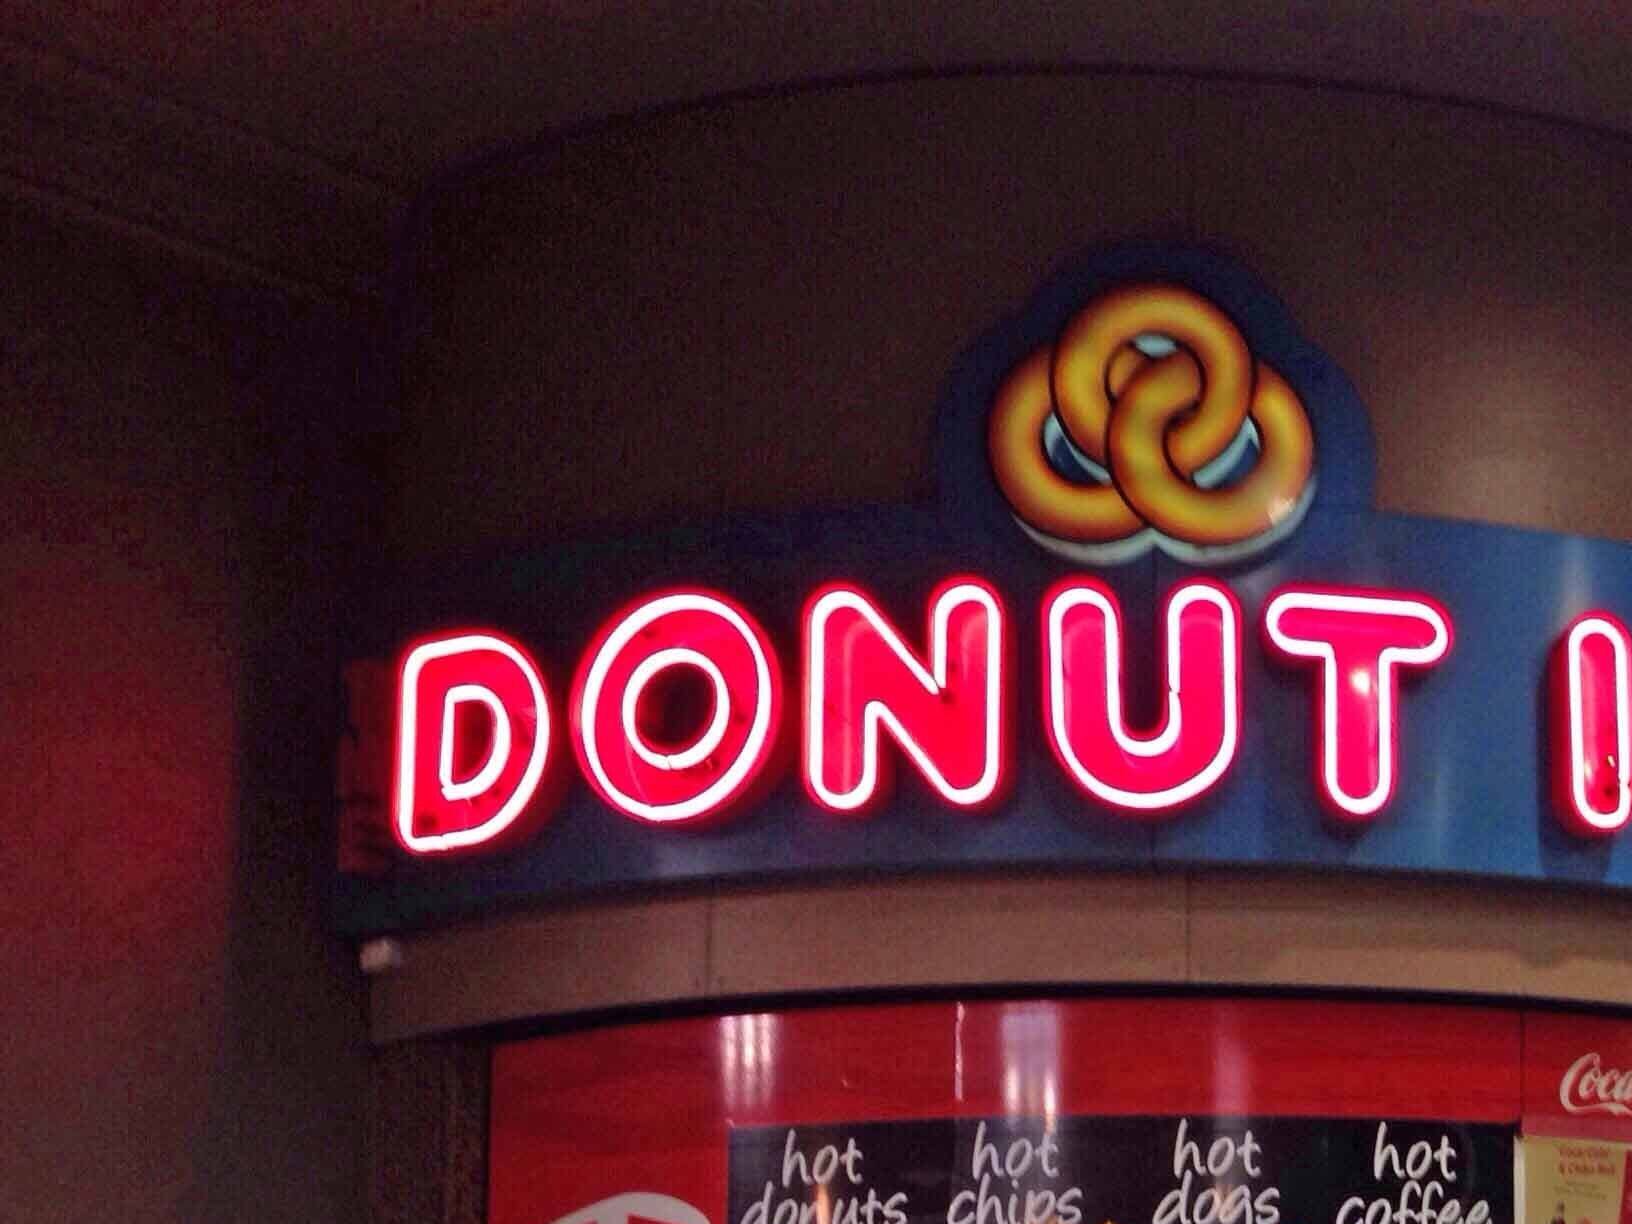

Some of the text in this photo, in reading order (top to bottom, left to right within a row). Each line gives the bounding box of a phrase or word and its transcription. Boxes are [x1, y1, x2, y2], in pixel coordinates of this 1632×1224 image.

[394, 580, 1455, 855] DONUT
[782, 1128, 864, 1188] hot
[972, 1120, 1060, 1180] hot
[1173, 1117, 1263, 1179] hot
[1373, 1121, 1457, 1182] hot
